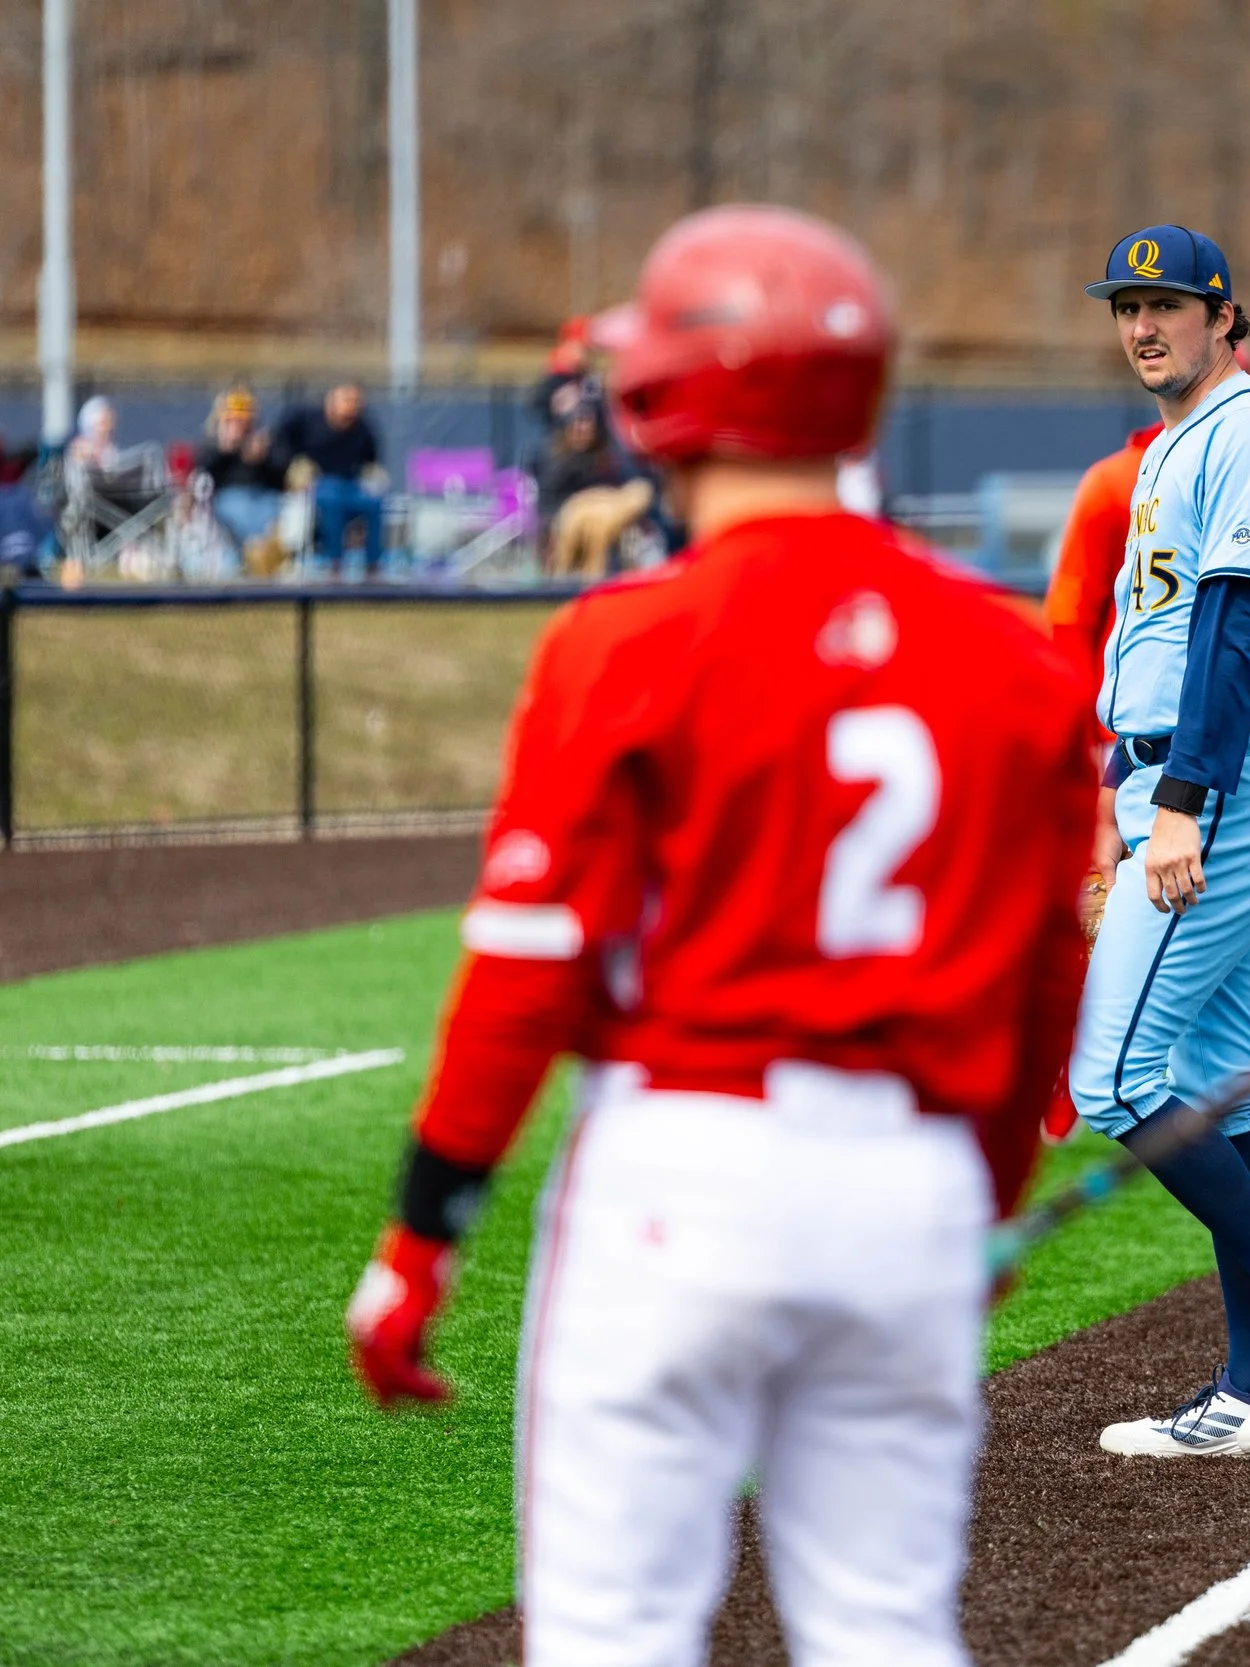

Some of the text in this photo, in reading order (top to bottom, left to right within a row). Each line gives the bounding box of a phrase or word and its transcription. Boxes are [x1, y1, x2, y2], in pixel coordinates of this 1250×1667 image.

[1127, 239, 1164, 279] Q
[1132, 549, 1181, 613] 45
[816, 704, 943, 960] 2
